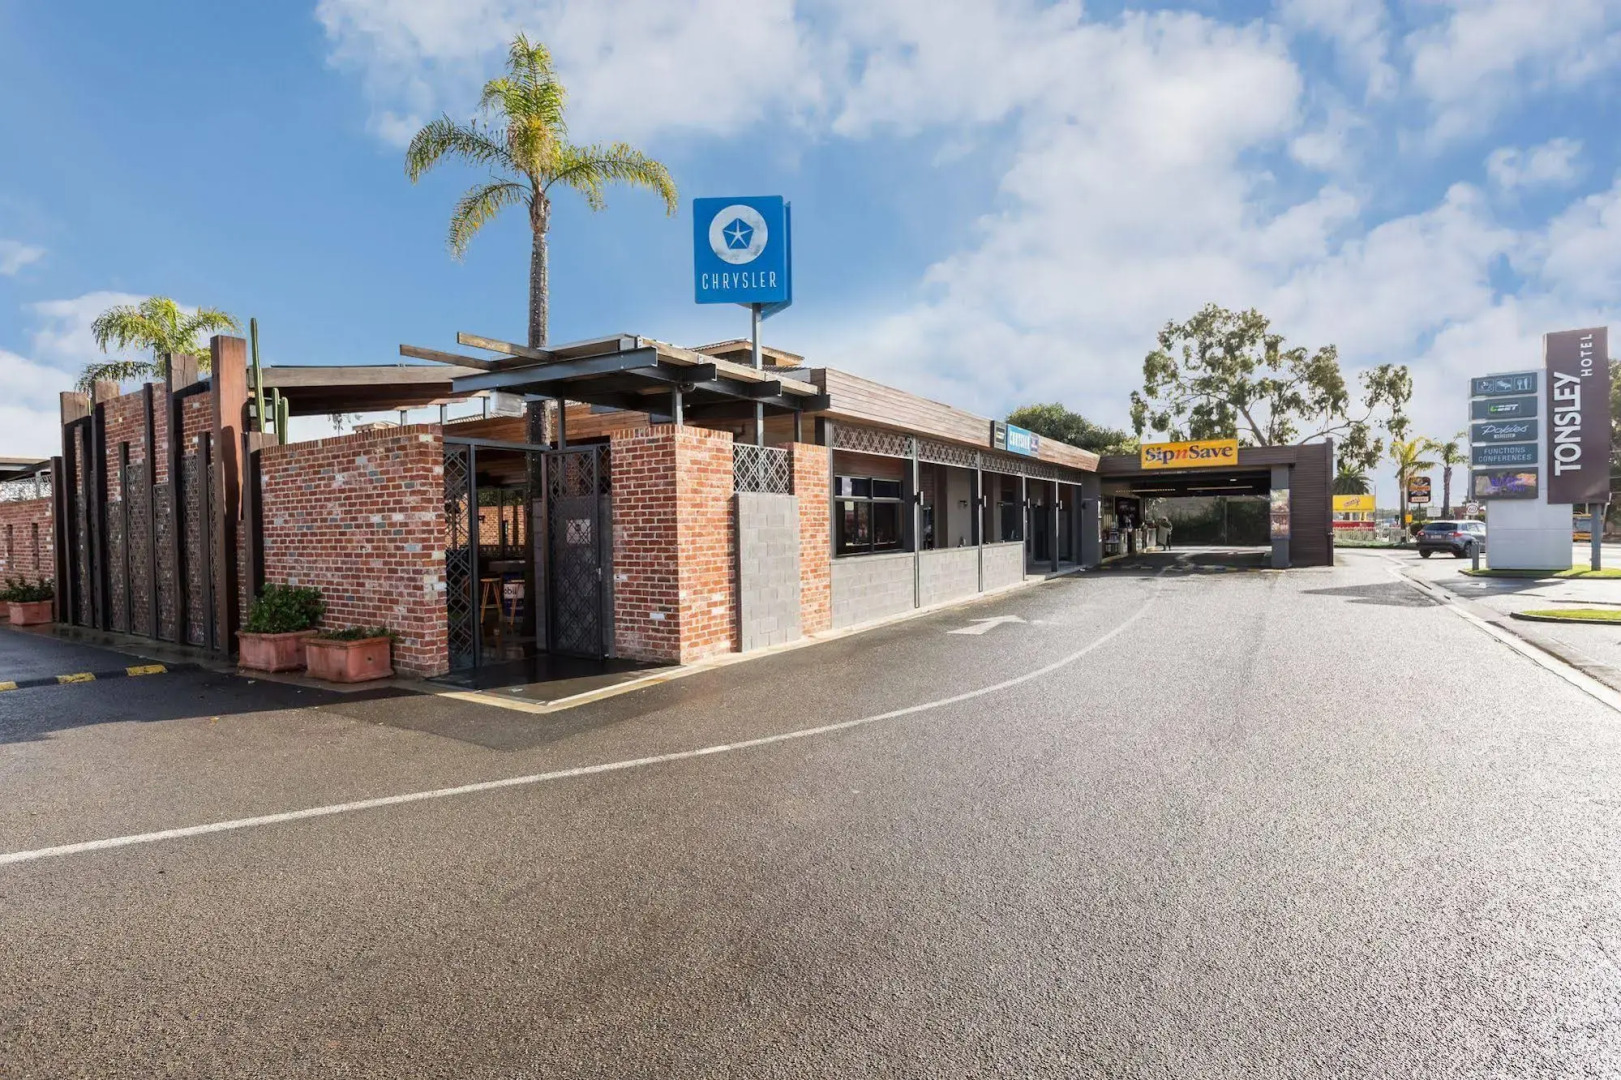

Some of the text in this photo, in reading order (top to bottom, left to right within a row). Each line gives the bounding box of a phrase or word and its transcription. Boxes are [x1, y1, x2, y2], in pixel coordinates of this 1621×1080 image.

[702, 271, 777, 290] CHRYSLER
[1580, 333, 1593, 377] HOTEL
[1553, 371, 1582, 476] TONSLEY
[1478, 453, 1532, 462] CONFERENCES
[1483, 446, 1526, 455] FUNCTIONS
